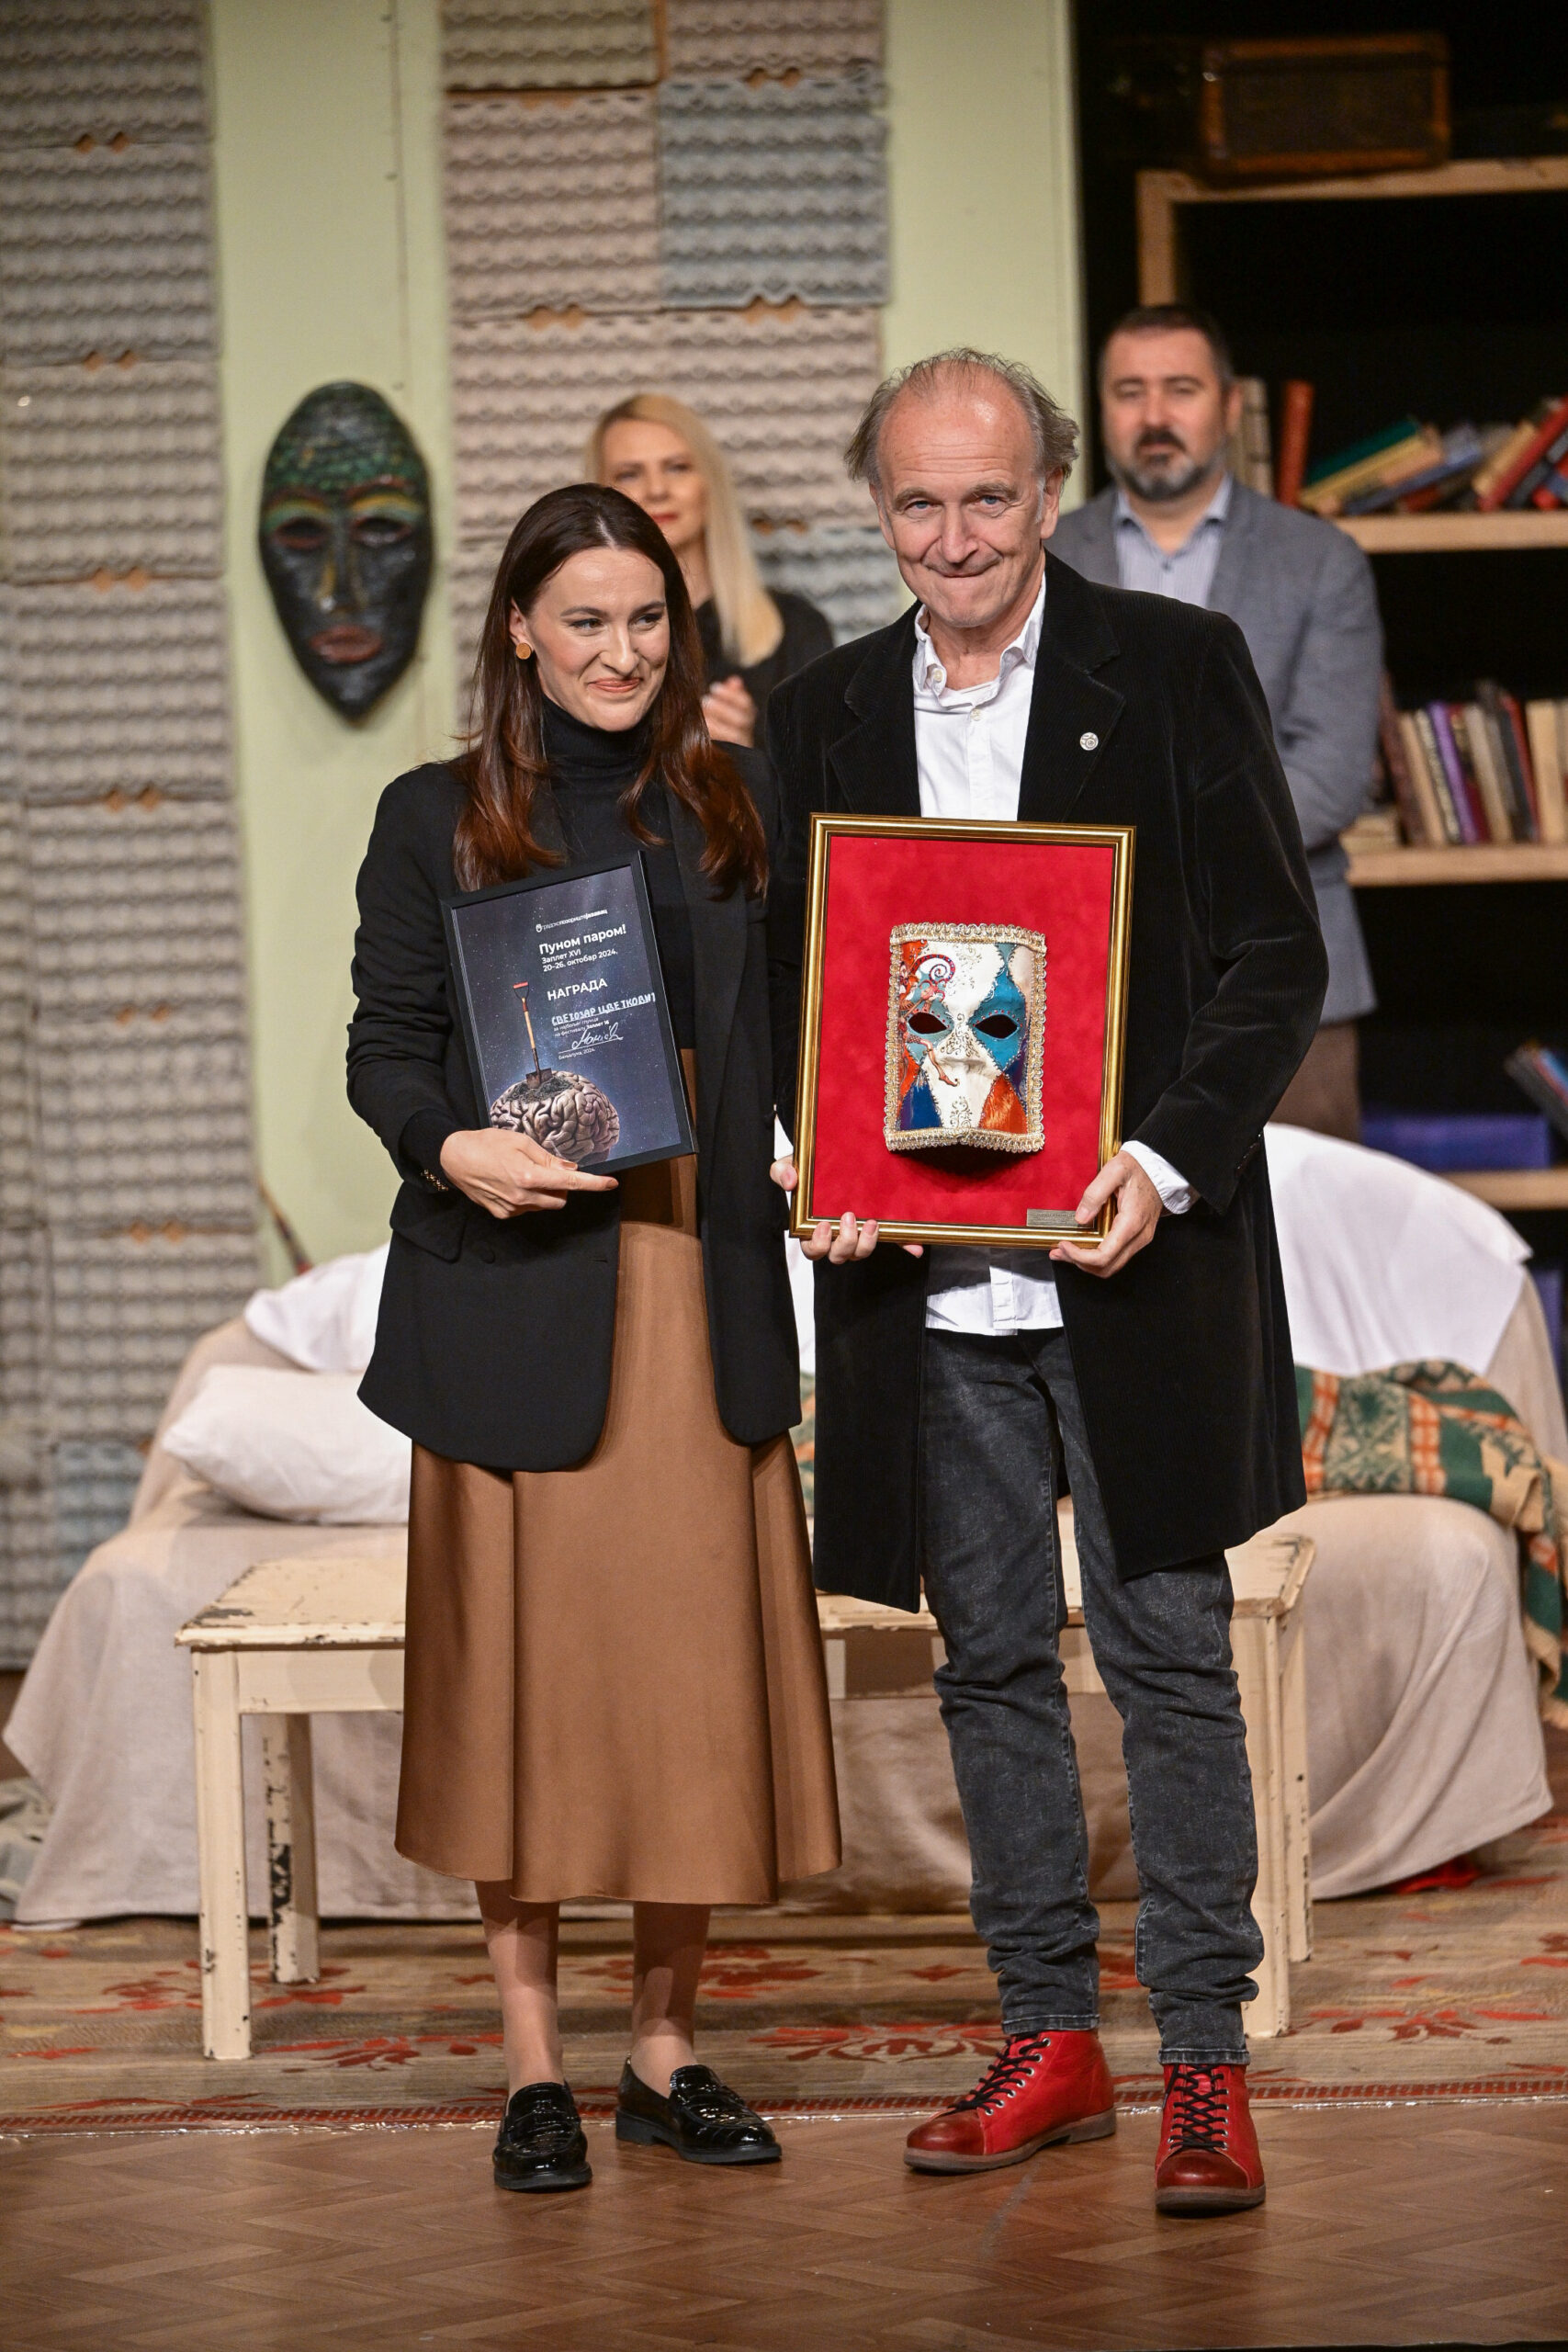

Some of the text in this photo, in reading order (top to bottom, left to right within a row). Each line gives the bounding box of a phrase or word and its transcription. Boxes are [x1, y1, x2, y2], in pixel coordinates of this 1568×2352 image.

[539, 923, 626, 956] Пуном паром!
[541, 948, 581, 964] Заплет XVI
[567, 955, 597, 966] октобар
[547, 978, 608, 1001] НАГРАДА
[551, 1008, 596, 1026] СВЕТОЗАР
